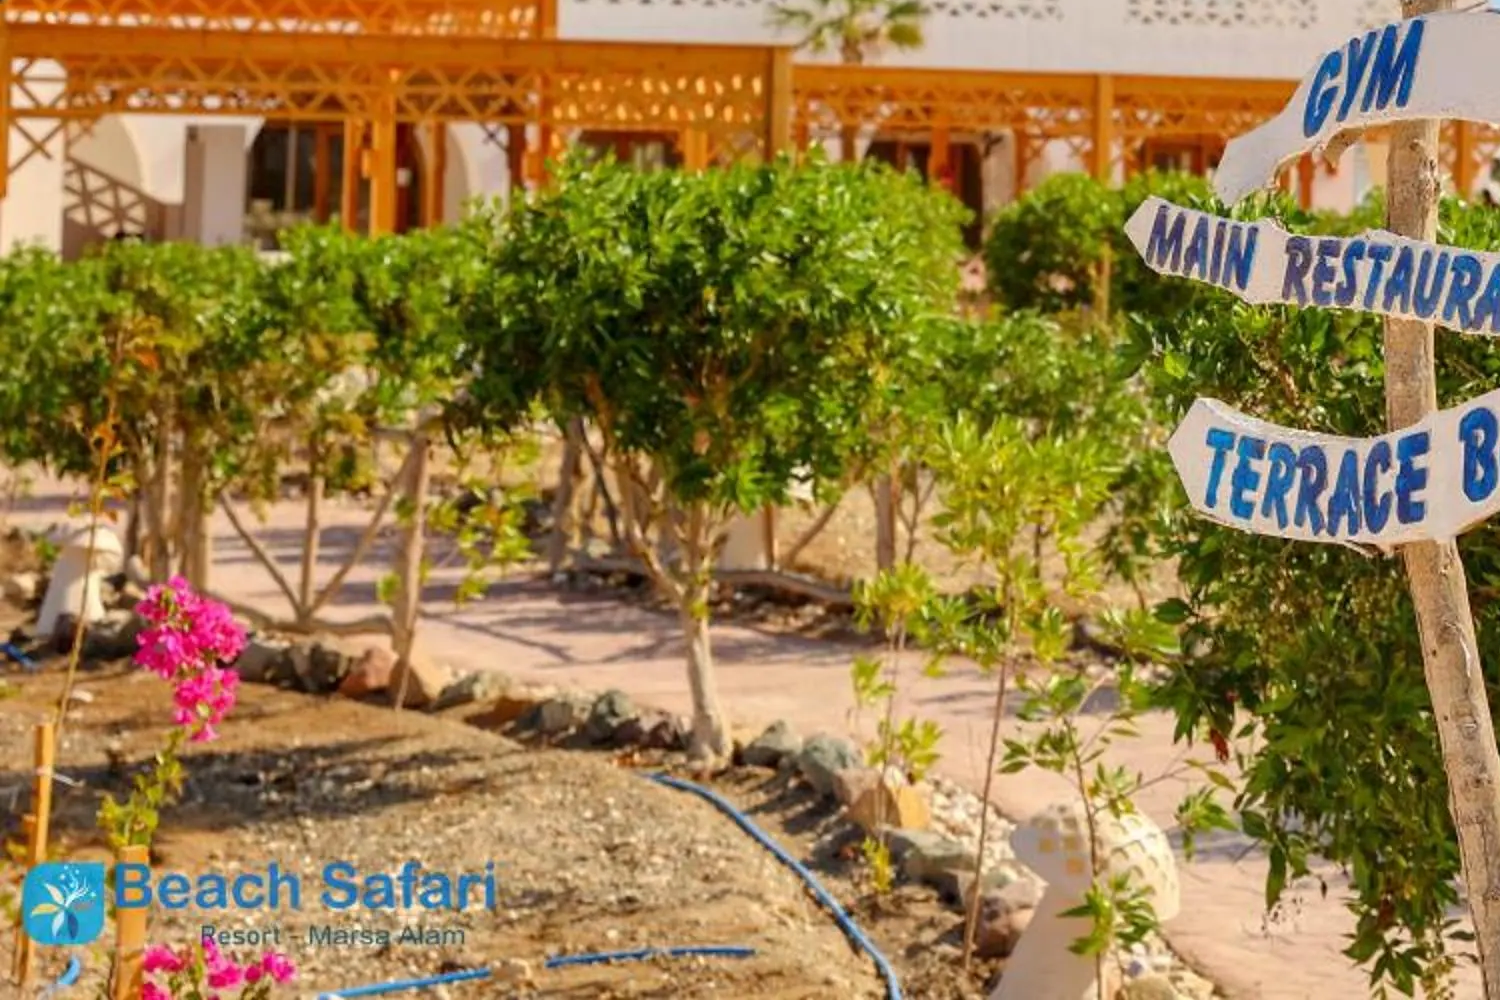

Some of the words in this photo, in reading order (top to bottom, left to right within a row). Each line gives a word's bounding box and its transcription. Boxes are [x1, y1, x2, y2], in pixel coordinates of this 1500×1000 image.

[1303, 18, 1426, 138] GYM
[1145, 205, 1259, 291] MAIN
[1203, 428, 1432, 536] TERRACE
